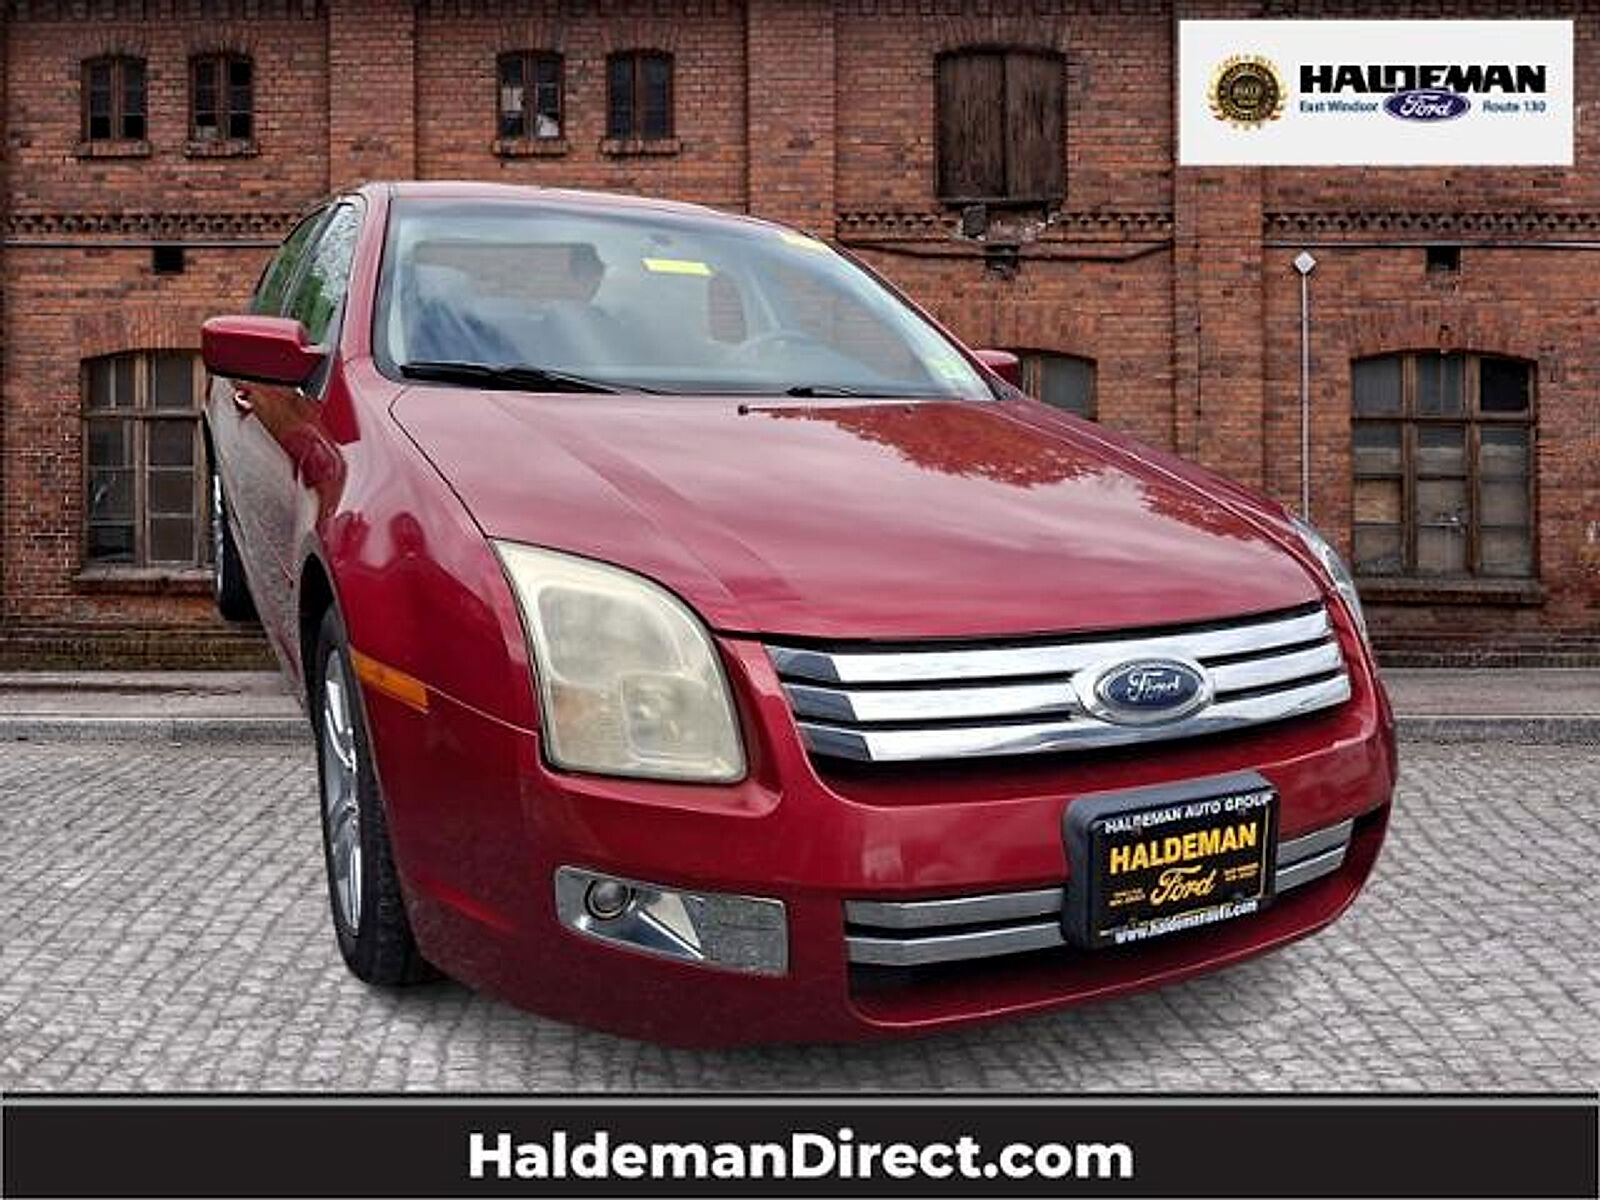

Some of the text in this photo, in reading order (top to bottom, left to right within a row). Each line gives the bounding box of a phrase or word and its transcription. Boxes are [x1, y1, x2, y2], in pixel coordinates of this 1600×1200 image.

[1126, 670, 1181, 701] Ford
[1185, 801, 1221, 818] AUTO
[1109, 822, 1257, 875] HALDEMAN
[1150, 865, 1218, 907] Ford
